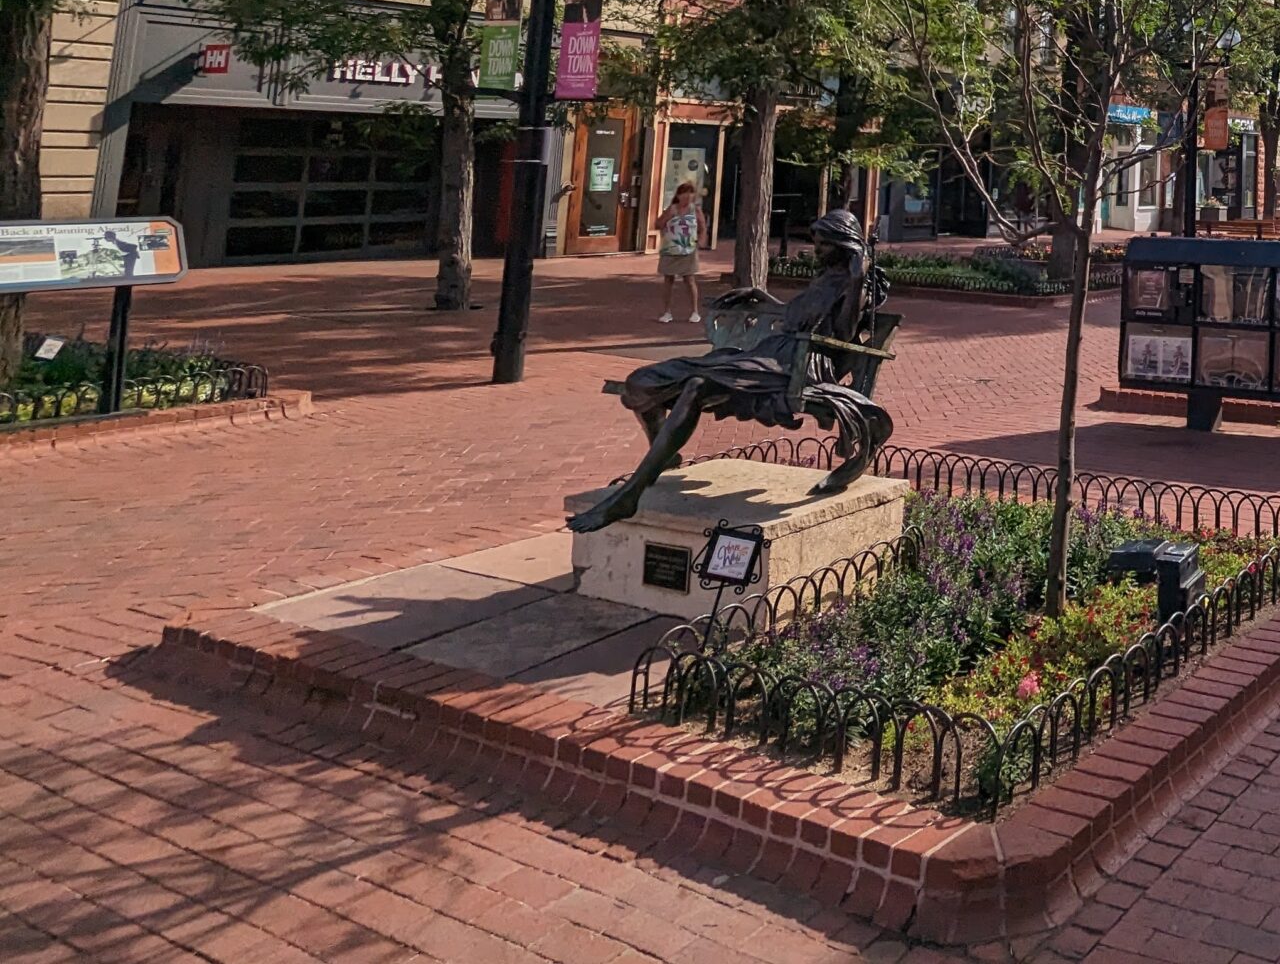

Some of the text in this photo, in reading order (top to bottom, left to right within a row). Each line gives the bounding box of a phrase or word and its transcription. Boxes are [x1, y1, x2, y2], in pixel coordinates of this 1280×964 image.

[488, 38, 514, 57] DOWN
[567, 37, 596, 54] DOWN
[205, 49, 227, 68] HH
[487, 57, 512, 76] TOWN
[567, 55, 594, 74] TOWN
[333, 59, 422, 84] HELLY
[1, 228, 30, 236] Back
[46, 227, 96, 236] Planning
[97, 225, 131, 234] Ahead
